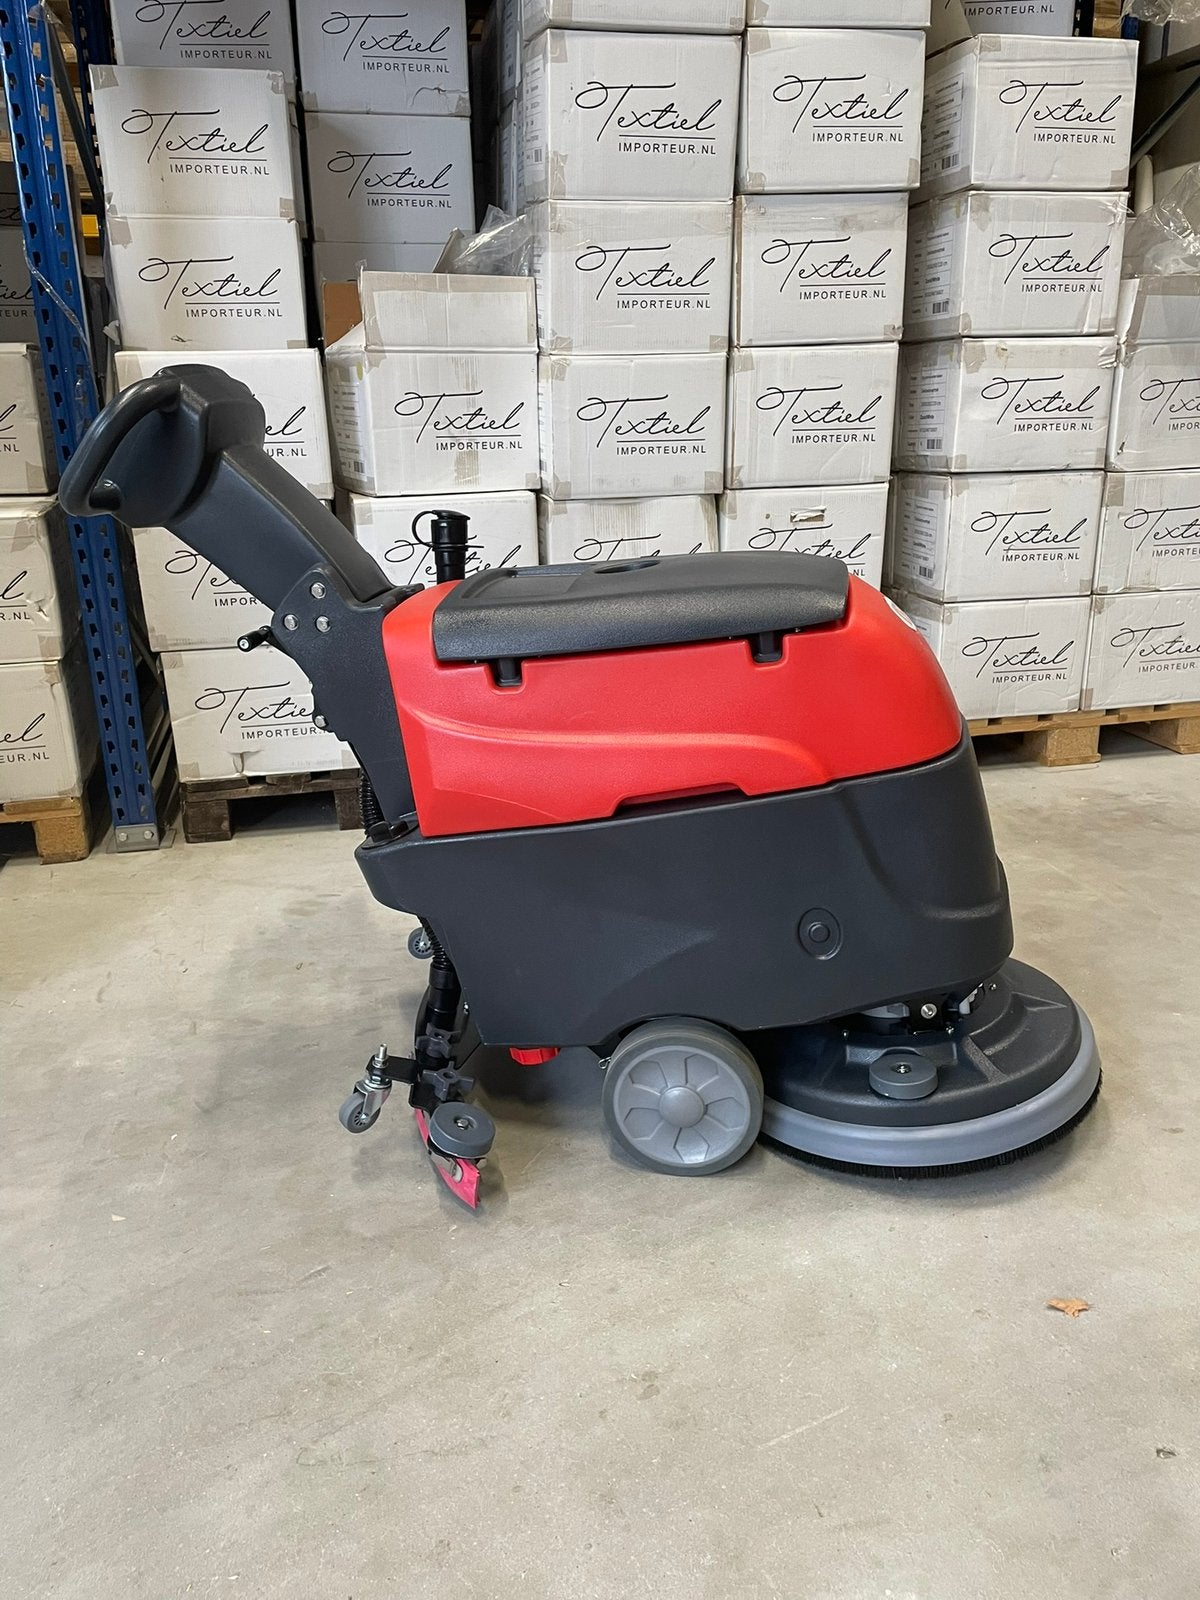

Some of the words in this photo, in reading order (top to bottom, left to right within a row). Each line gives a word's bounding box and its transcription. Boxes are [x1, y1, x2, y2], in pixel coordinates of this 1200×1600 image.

[964, 4, 1054, 16] IMPORTEUR.NL
[135, 0, 270, 49] Textiel
[322, 12, 450, 61] Textiel
[180, 49, 272, 59] IMPORTEUR.NL
[363, 61, 449, 73] IMPORTEUR.NL
[773, 75, 909, 133] Textiel
[999, 80, 1122, 133] Textiel
[575, 82, 722, 142] Textiel
[121, 109, 269, 163] Textiel
[813, 132, 903, 142] IMPORTEUR.NL
[1034, 133, 1115, 144] IMPORTEUR.NL
[618, 142, 716, 155] IMPORTEUR.NL
[169, 164, 269, 175] IMPORTEUR.NL
[327, 150, 452, 198] Textiel
[367, 198, 451, 208] IMPORTEUR.NL
[761, 237, 891, 293] Textiel
[988, 233, 1109, 284] Textiel
[575, 244, 715, 300] Textiel
[138, 256, 281, 309] Textiel
[1022, 283, 1102, 293] IMPORTEUR.NL
[799, 290, 886, 300] IMPORTEUR.NL
[617, 300, 710, 309] IMPORTEUR.NL
[186, 308, 282, 318] IMPORTEUR.NL
[981, 375, 1100, 424] Textiel
[394, 390, 524, 443] Textiel
[756, 384, 882, 436] Textiel
[577, 394, 711, 447] Textiel
[1014, 422, 1093, 431] IMPORTEUR.NL
[792, 433, 876, 443] IMPORTEUR.NL
[436, 441, 522, 450] IMPORTEUR.NL
[616, 445, 706, 455] IMPORTEUR.NL
[971, 508, 1087, 555] Textiel
[1002, 553, 1079, 562] IMPORTEUR.NL
[1152, 548, 1200, 557] IMPORTE
[385, 535, 522, 585] Tetiel
[1111, 622, 1200, 668] Textie
[962, 632, 1073, 678] Textiel
[1139, 662, 1199, 673] IMPORTEUR.
[992, 673, 1067, 684] IMPORTEUR.NL
[195, 682, 313, 734] Textie
[241, 727, 328, 739] IMPORTEUR.
